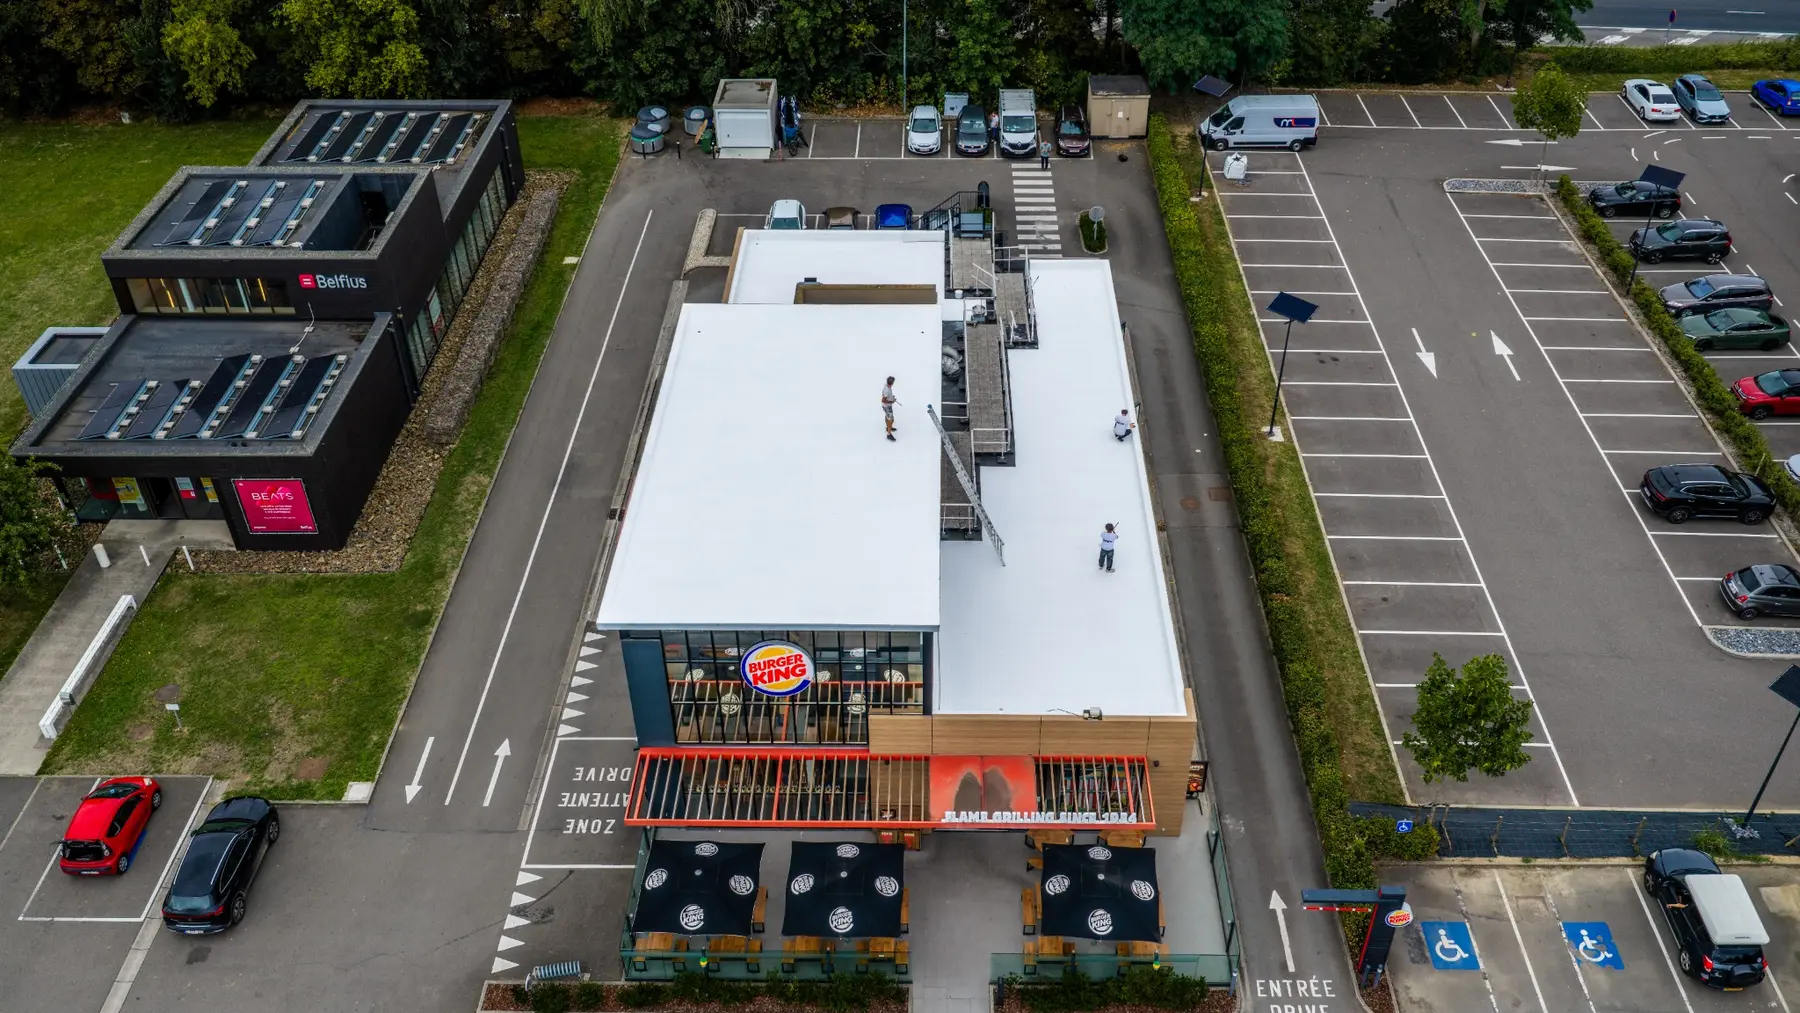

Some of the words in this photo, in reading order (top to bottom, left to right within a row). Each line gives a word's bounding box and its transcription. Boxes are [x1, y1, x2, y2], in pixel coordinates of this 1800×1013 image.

[316, 274, 367, 288] Belfius
[251, 492, 294, 501] BEATS
[748, 653, 804, 673] BURGER
[752, 663, 807, 686] KING
[572, 767, 632, 782] DRIVE
[992, 811, 1055, 823] GRILLING
[1059, 812, 1097, 823] SINCE
[562, 819, 616, 834] ZONE
[1256, 975, 1336, 997] ENTRÉE
